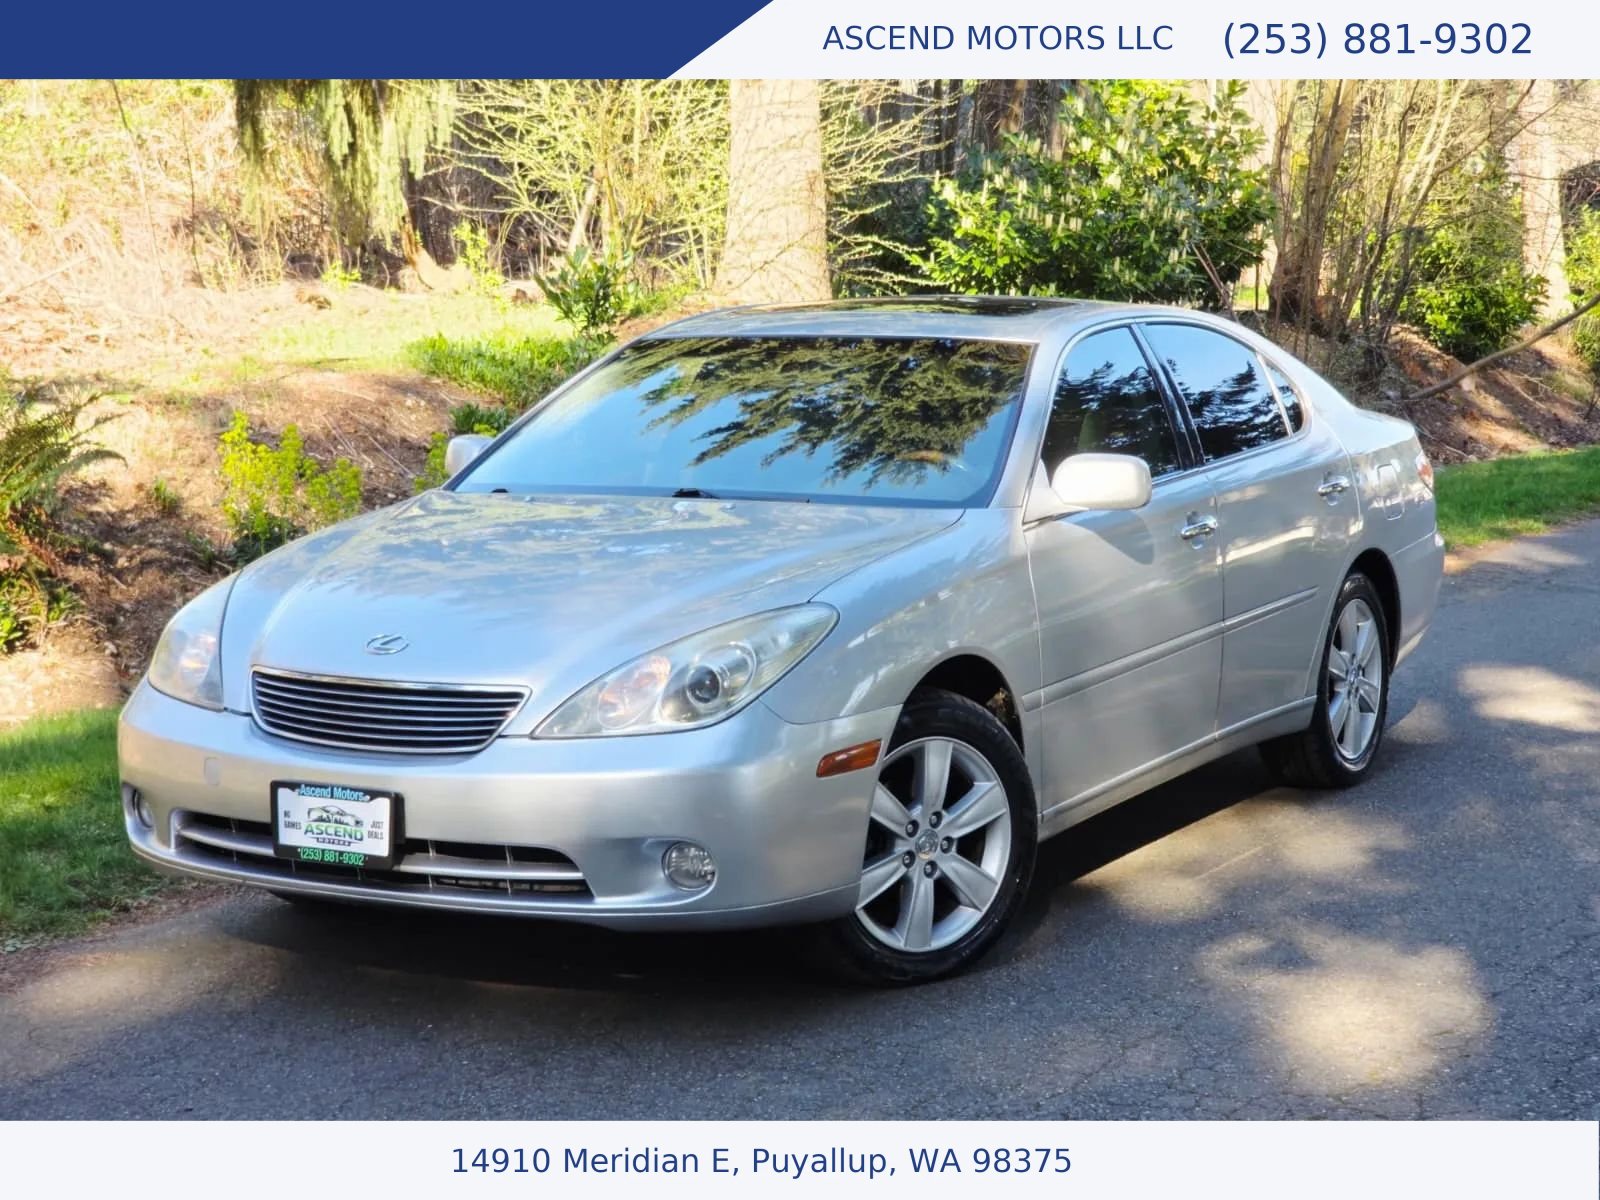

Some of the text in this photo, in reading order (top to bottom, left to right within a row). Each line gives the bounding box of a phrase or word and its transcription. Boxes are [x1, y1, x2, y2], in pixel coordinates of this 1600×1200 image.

[300, 784, 363, 801] Ascend Motors
[304, 823, 364, 841] ASCEND
[370, 820, 384, 829] JUST
[367, 830, 384, 840] DEALS
[300, 848, 365, 865] (253) 881-9302
